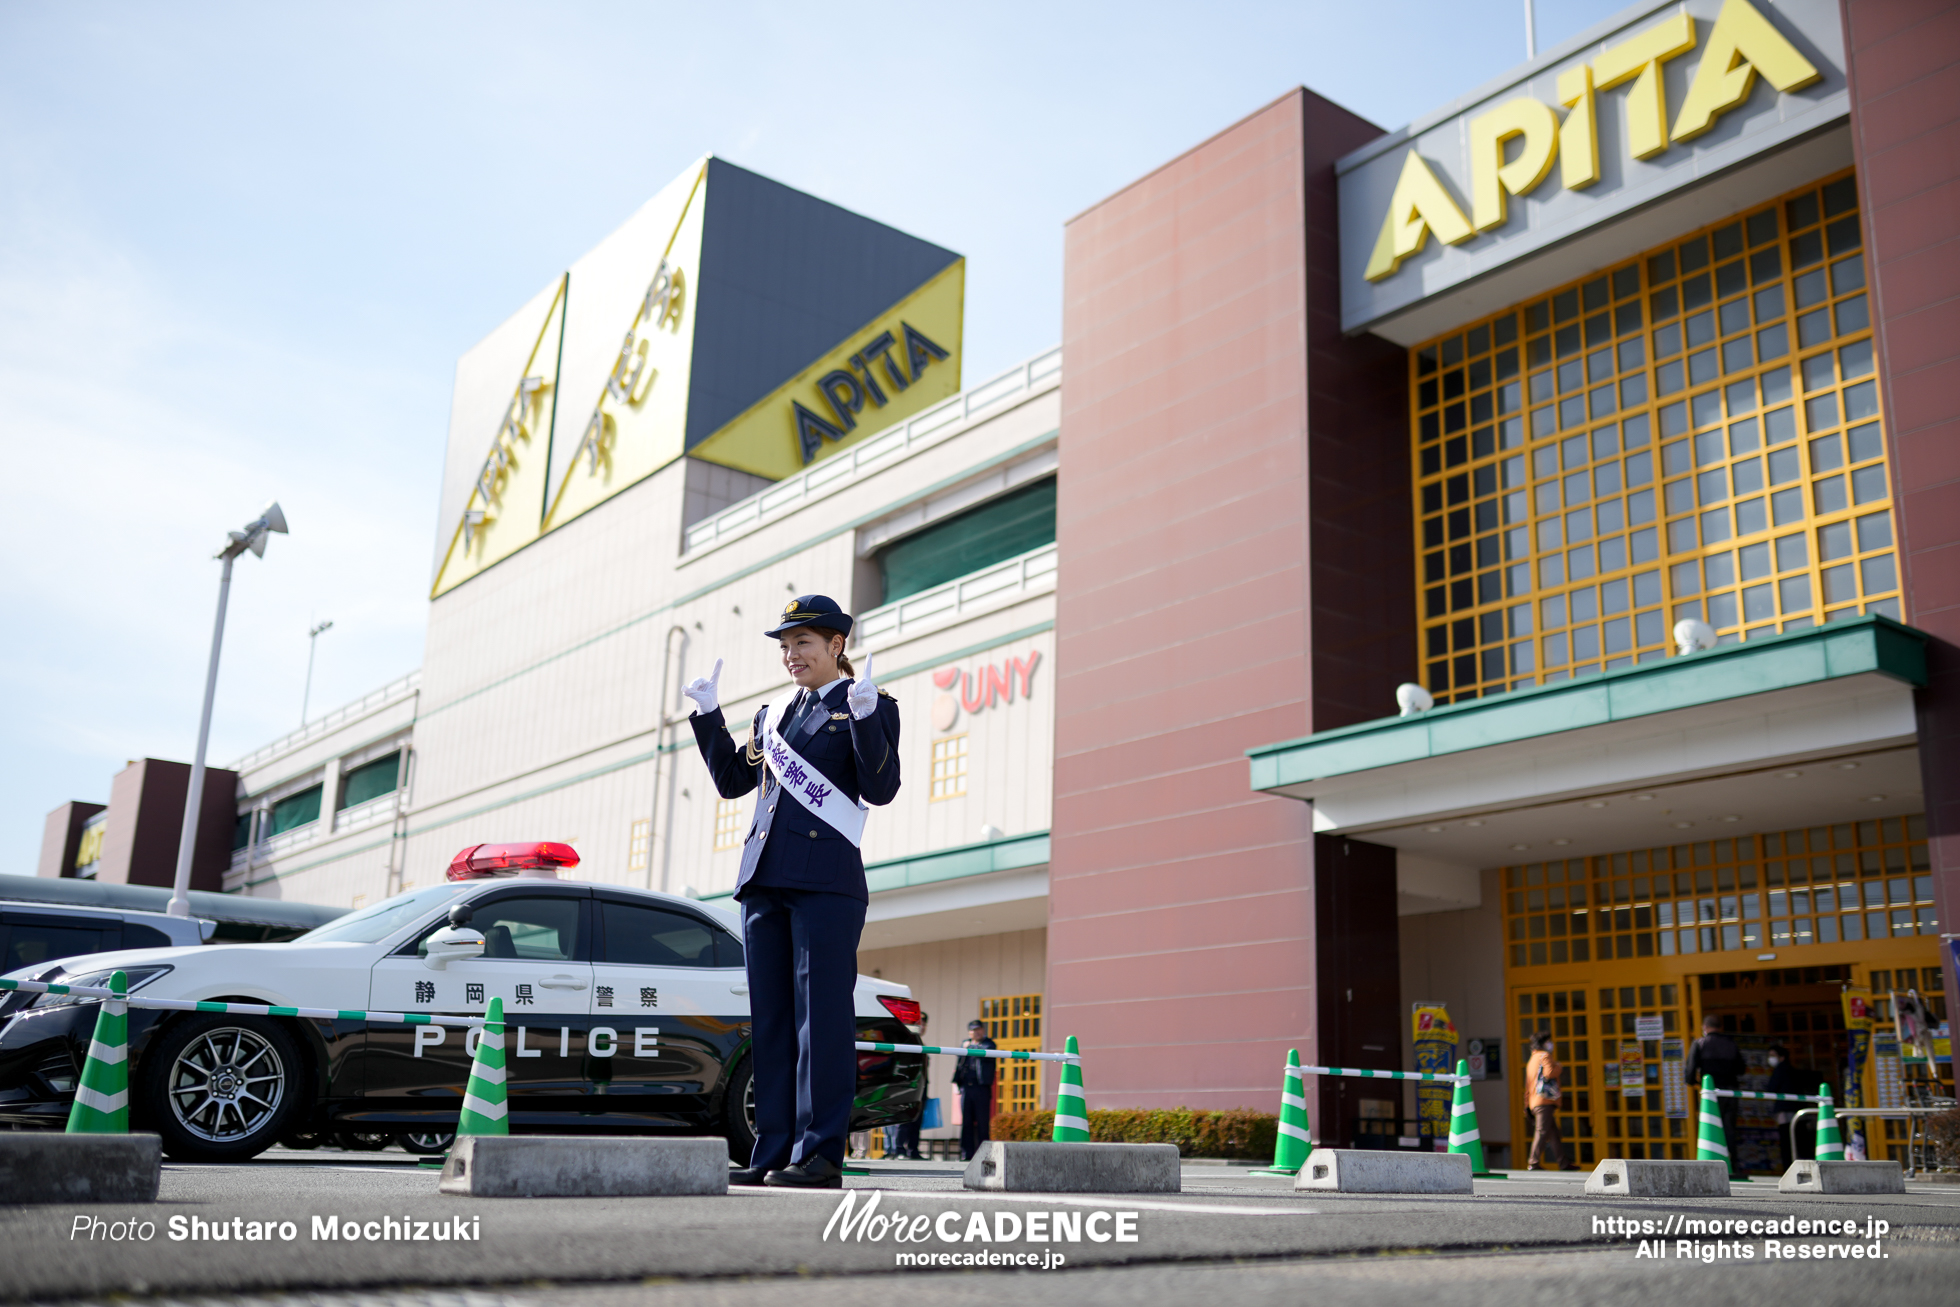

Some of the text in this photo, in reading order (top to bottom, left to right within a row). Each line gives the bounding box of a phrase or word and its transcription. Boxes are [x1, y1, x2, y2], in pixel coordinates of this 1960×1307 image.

[1364, 0, 1824, 282] APITA
[790, 319, 952, 467] APITA
[961, 650, 1041, 714] UNY
